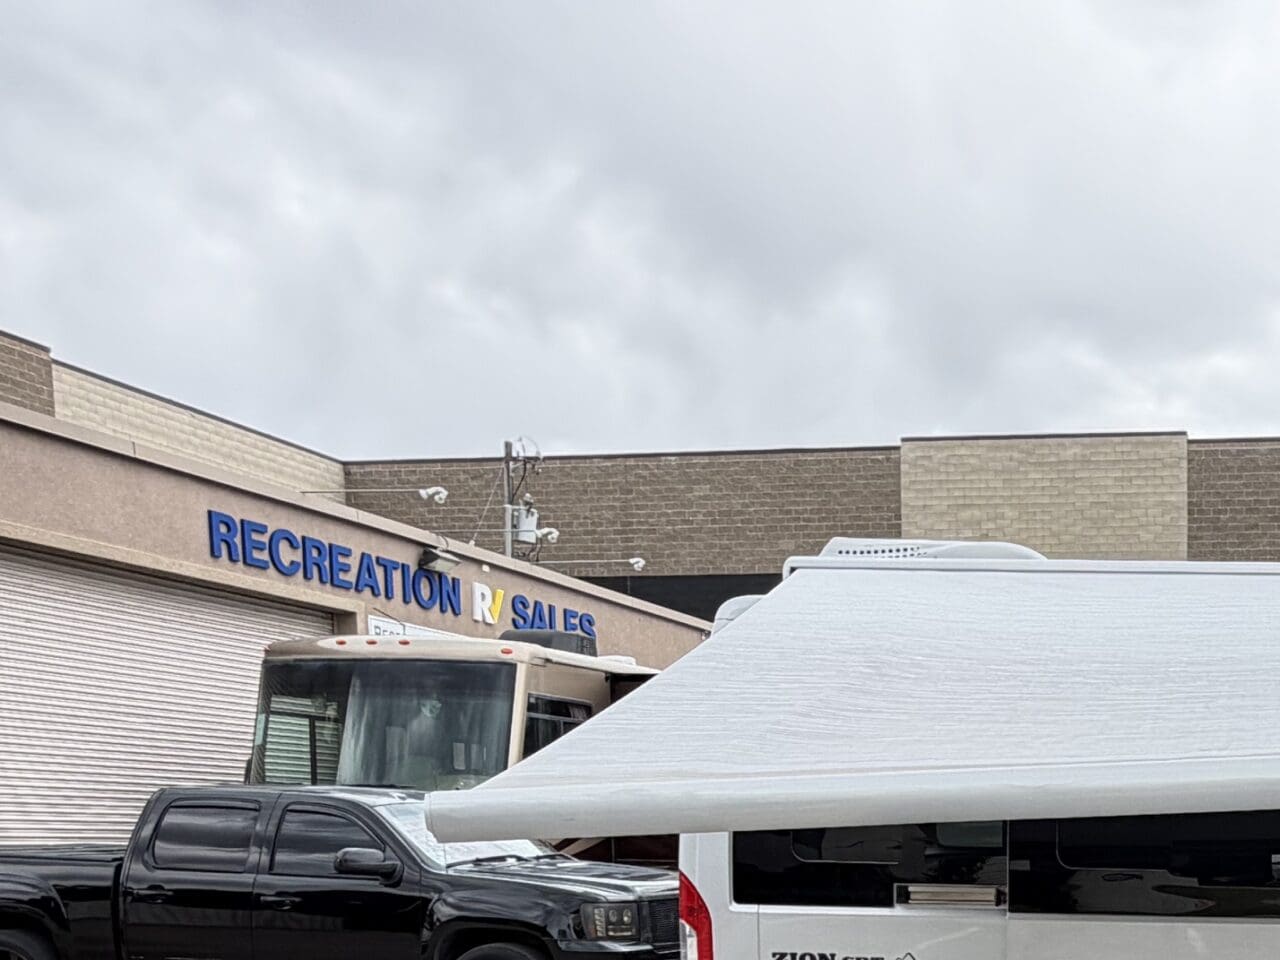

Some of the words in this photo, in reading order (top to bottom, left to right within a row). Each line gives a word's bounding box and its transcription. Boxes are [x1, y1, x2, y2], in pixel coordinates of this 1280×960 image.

[208, 510, 461, 616] RECREATION
[472, 582, 504, 625] RV
[511, 594, 596, 637] SALES
